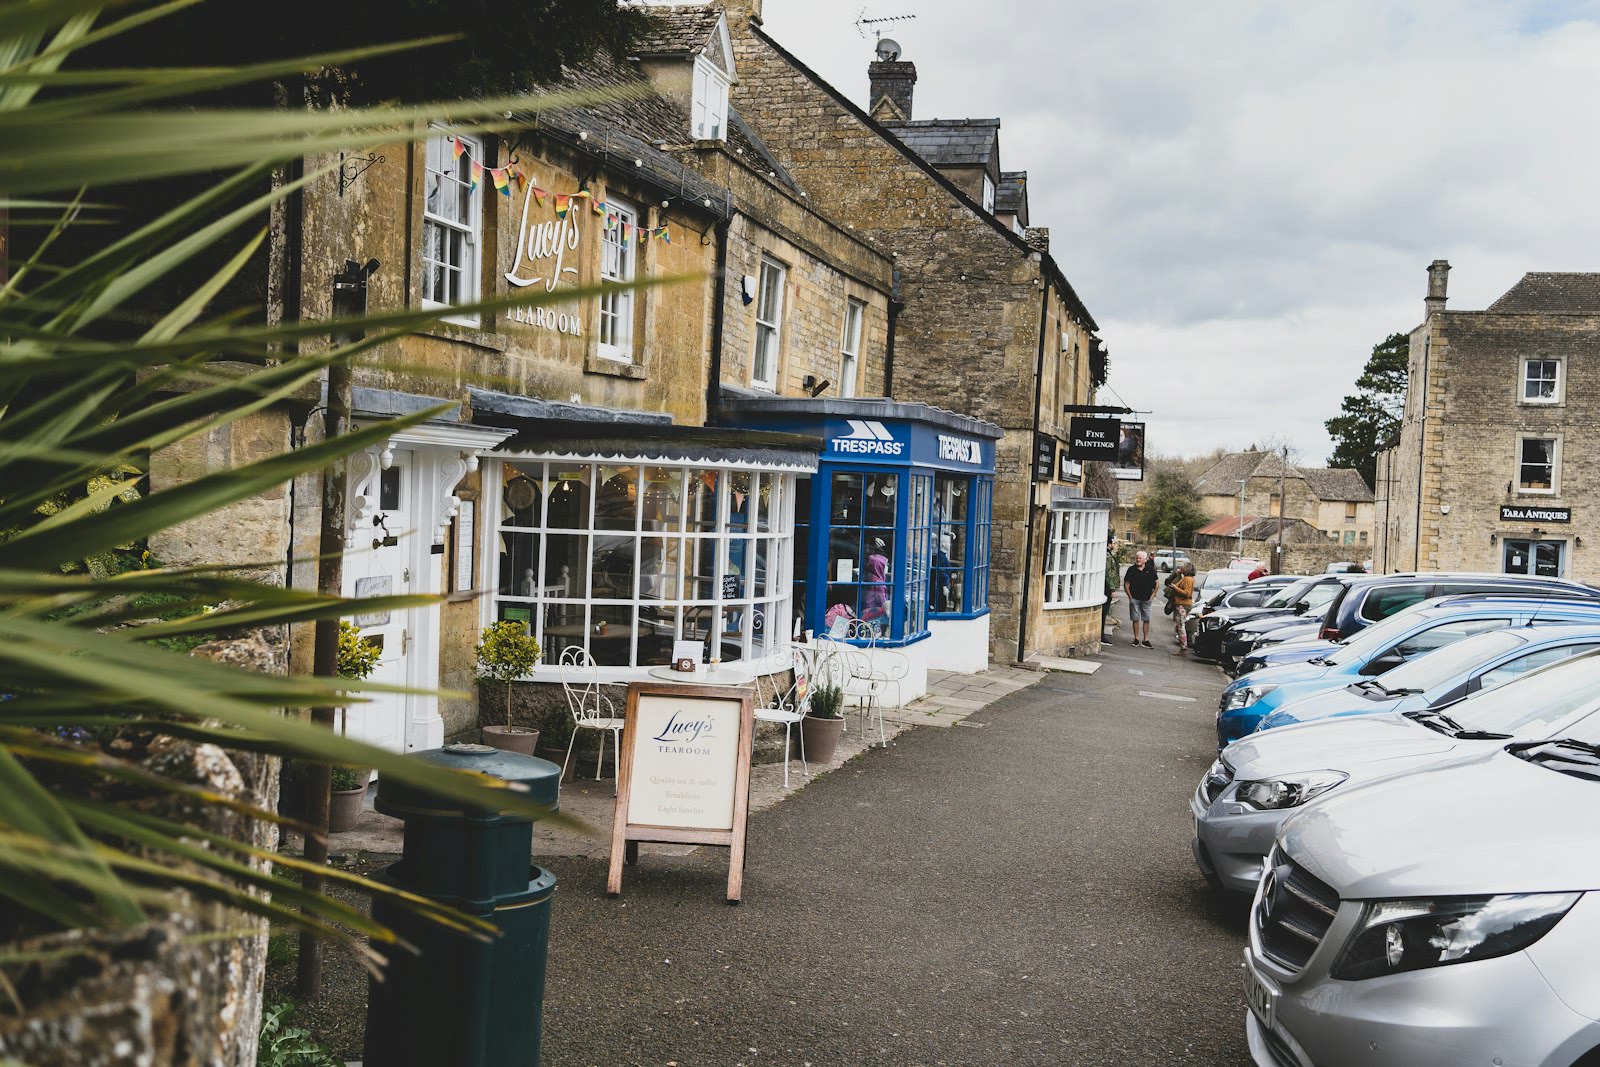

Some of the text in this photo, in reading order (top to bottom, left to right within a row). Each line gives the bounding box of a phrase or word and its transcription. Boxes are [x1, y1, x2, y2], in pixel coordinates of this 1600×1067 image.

[504, 177, 579, 293] Lucy's
[506, 303, 581, 336] TEAROOM
[1086, 430, 1105, 438] FINE
[831, 439, 902, 455] TRESPASS
[938, 434, 970, 462] TRESPASS
[1075, 439, 1114, 448] PAINTINGS
[1503, 509, 1568, 520] TARA ANTIQUES
[652, 710, 715, 742] Lucy's
[658, 745, 710, 755] TEAROOM
